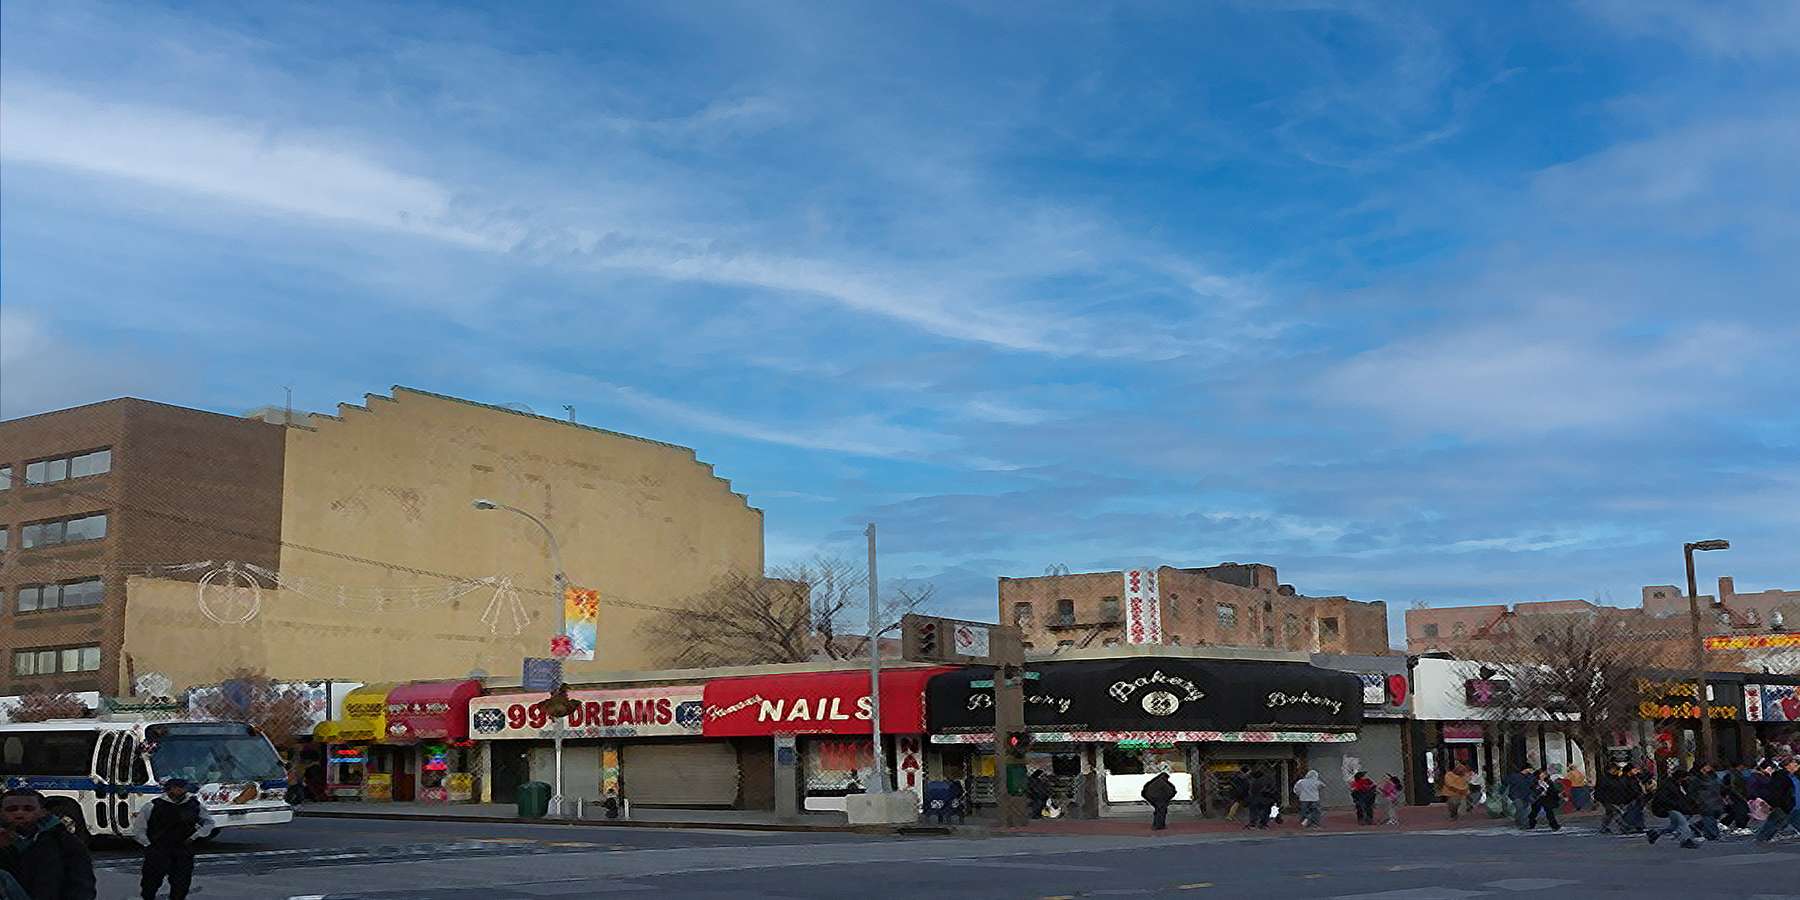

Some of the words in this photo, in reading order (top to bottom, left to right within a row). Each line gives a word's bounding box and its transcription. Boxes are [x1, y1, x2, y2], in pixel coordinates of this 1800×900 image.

[1108, 670, 1205, 703] Bakery
[568, 699, 673, 728] DREAMS
[758, 696, 876, 722] NAILS
[1266, 690, 1343, 714] Bakery
